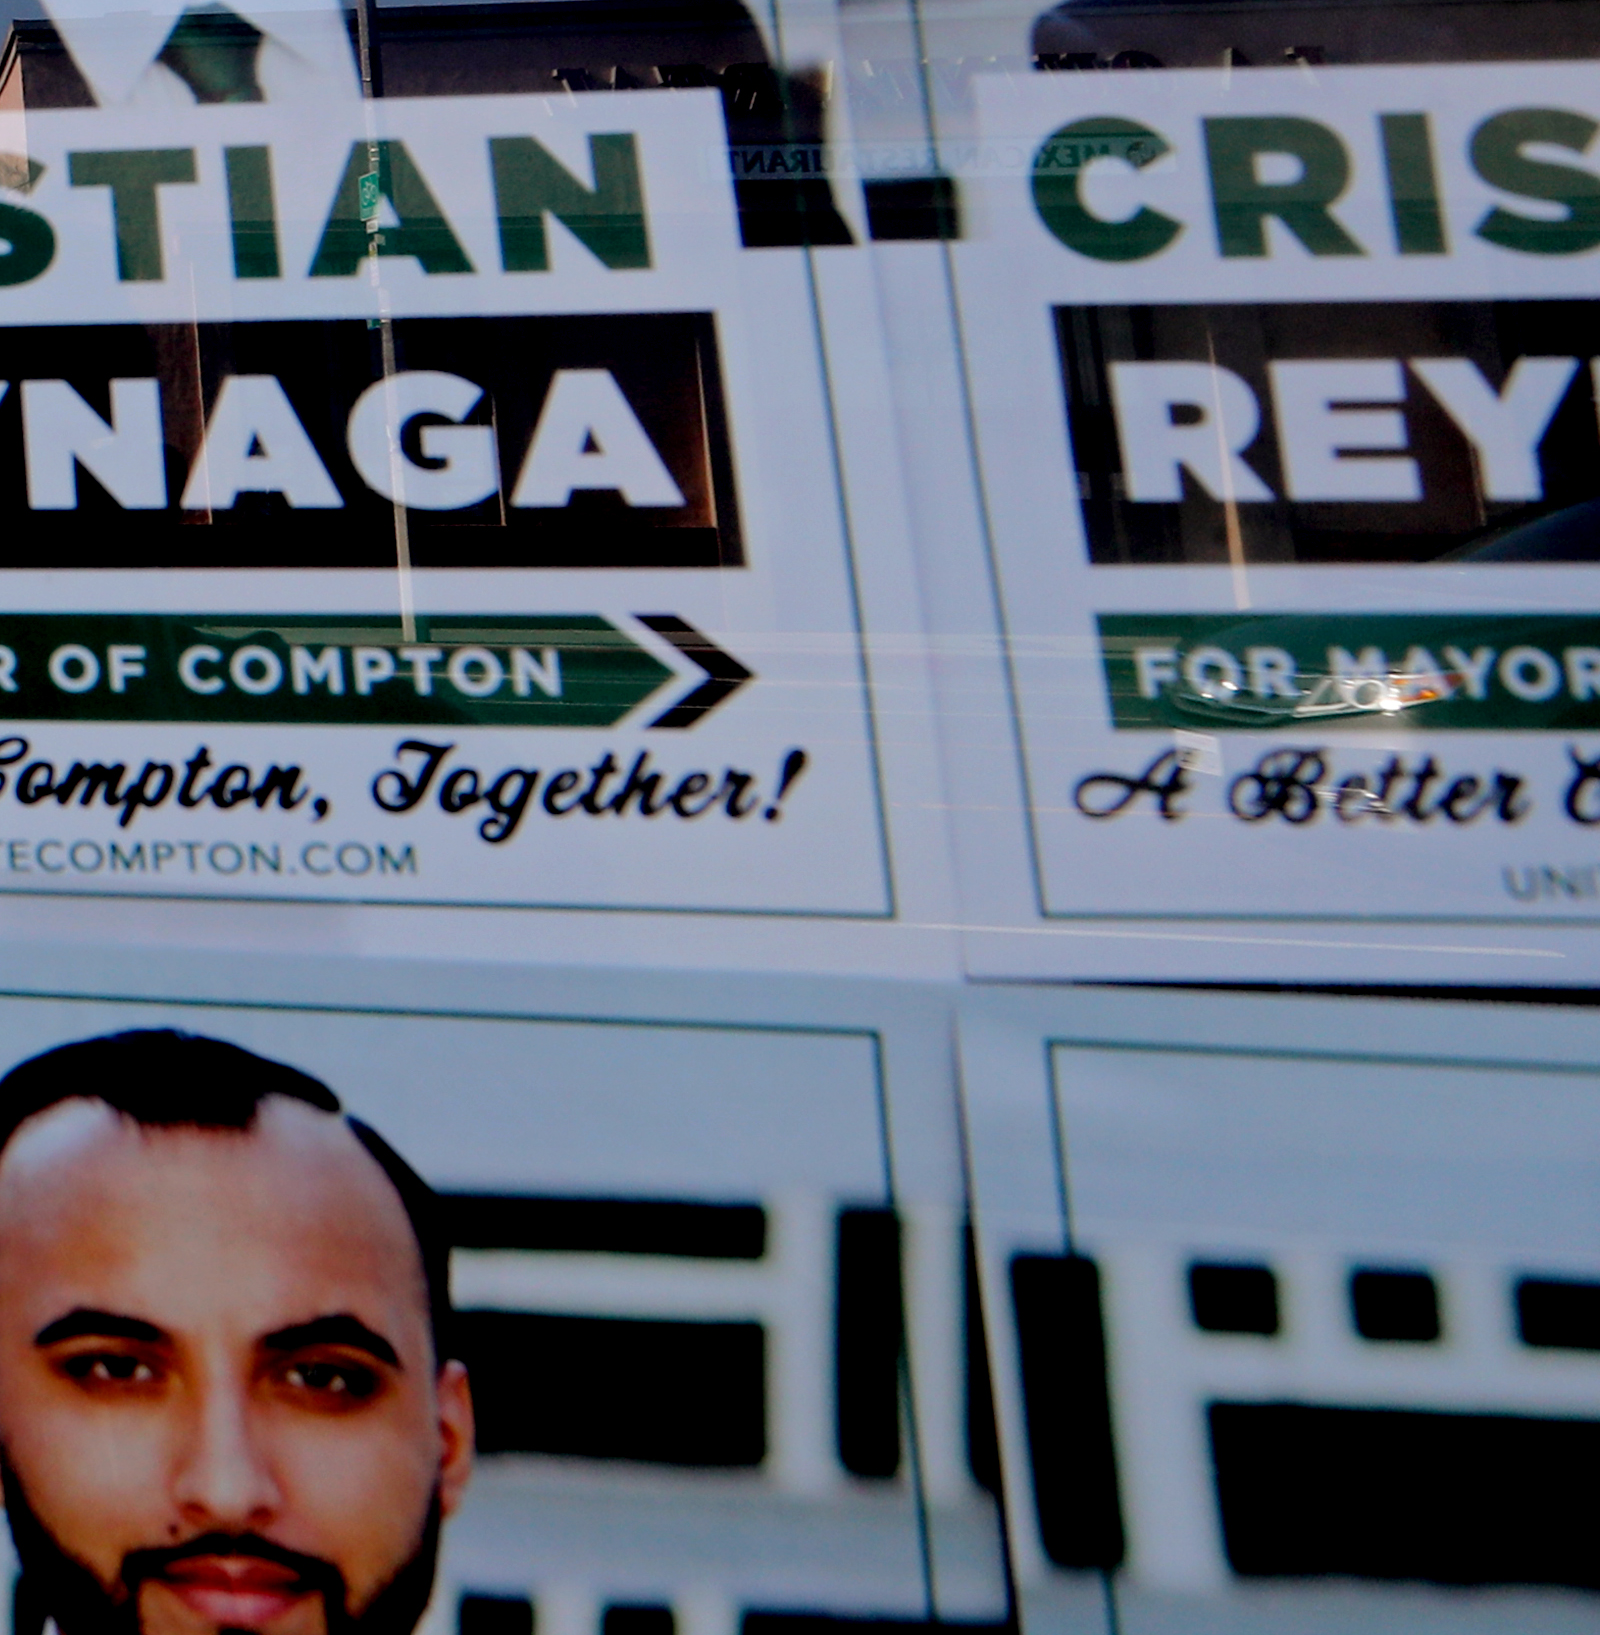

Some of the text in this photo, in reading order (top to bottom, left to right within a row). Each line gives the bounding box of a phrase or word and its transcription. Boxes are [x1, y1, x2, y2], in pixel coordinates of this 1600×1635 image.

[1031, 107, 1600, 263] CRIS
[1109, 357, 1600, 504] REY
[46, 643, 145, 696] OF
[176, 643, 563, 700] COMPTON
[1135, 645, 1298, 704] FOR
[369, 737, 809, 844] Together!
[1073, 747, 1189, 822] A
[1229, 746, 1532, 826] Better
